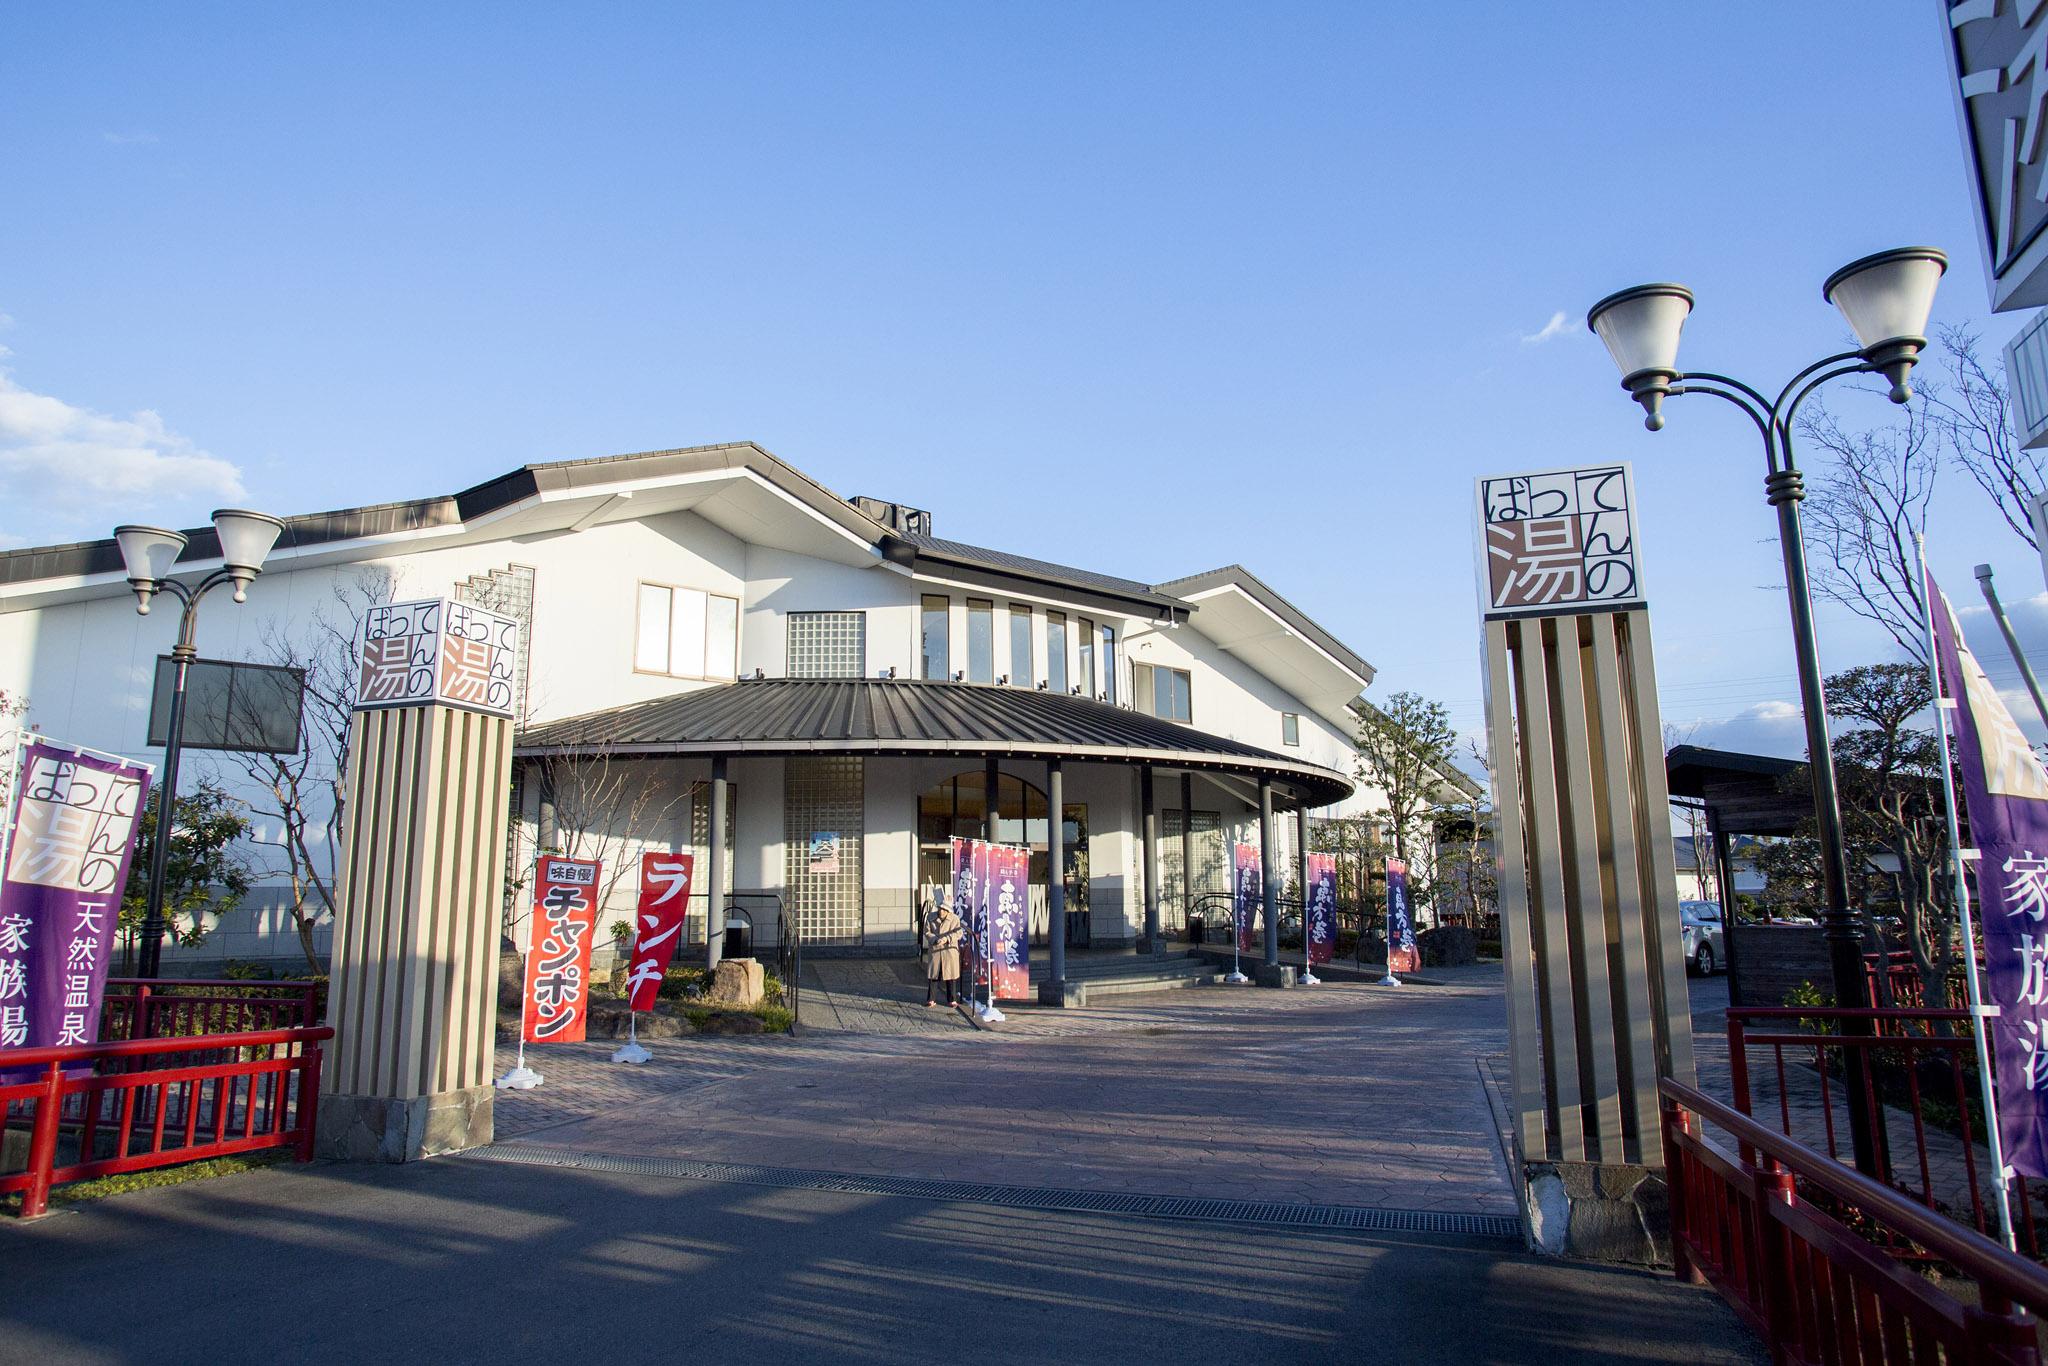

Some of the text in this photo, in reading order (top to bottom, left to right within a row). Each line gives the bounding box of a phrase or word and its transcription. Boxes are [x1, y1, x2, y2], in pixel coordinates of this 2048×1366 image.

[551, 865, 592, 882] 味自慢
[627, 861, 688, 1007] ランチ
[56, 901, 107, 1047] 天然温泉
[534, 885, 589, 1039] チャンポン
